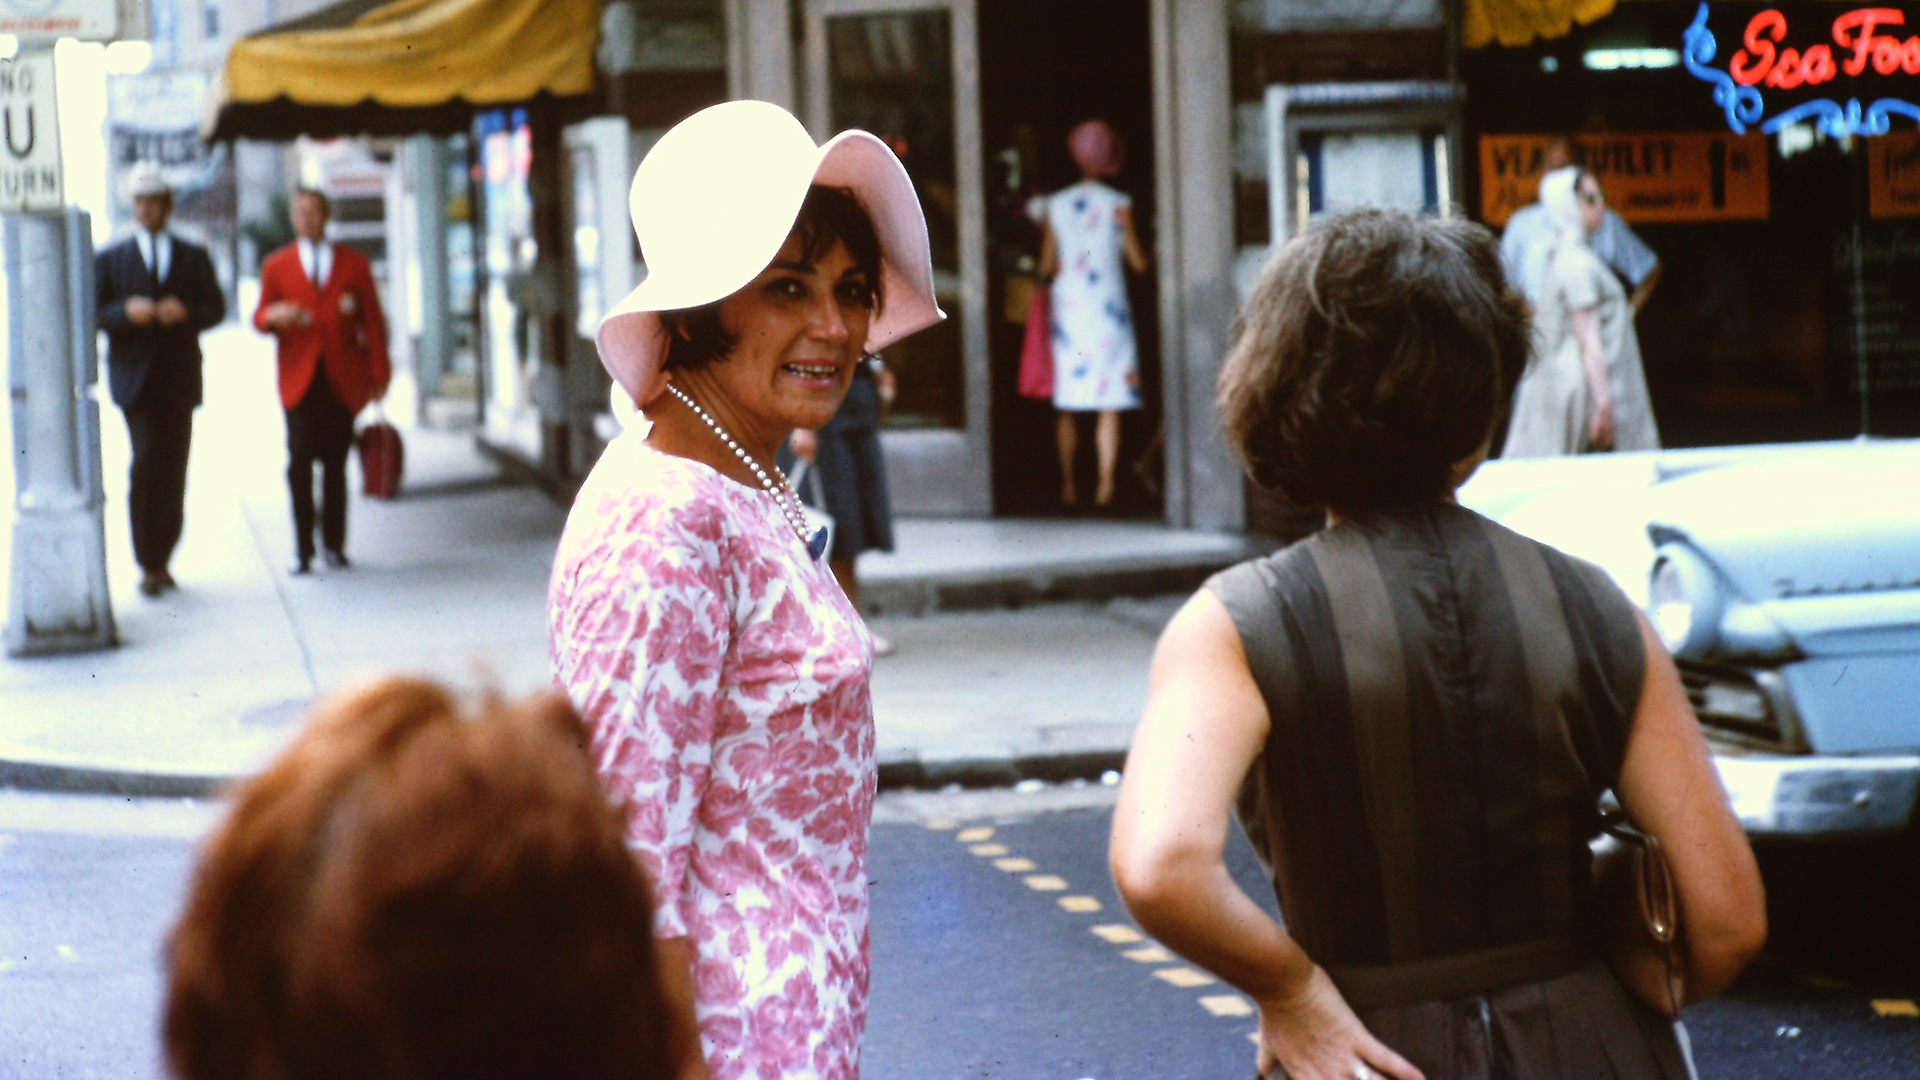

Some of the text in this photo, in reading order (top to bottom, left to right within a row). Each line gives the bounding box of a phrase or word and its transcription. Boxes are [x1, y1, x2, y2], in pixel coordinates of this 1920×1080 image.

[1730, 9, 1837, 90] Sea
[0, 66, 36, 96] NO
[4, 104, 35, 160] U
[1492, 144, 1546, 177] VEA
[0, 166, 56, 198] URN
